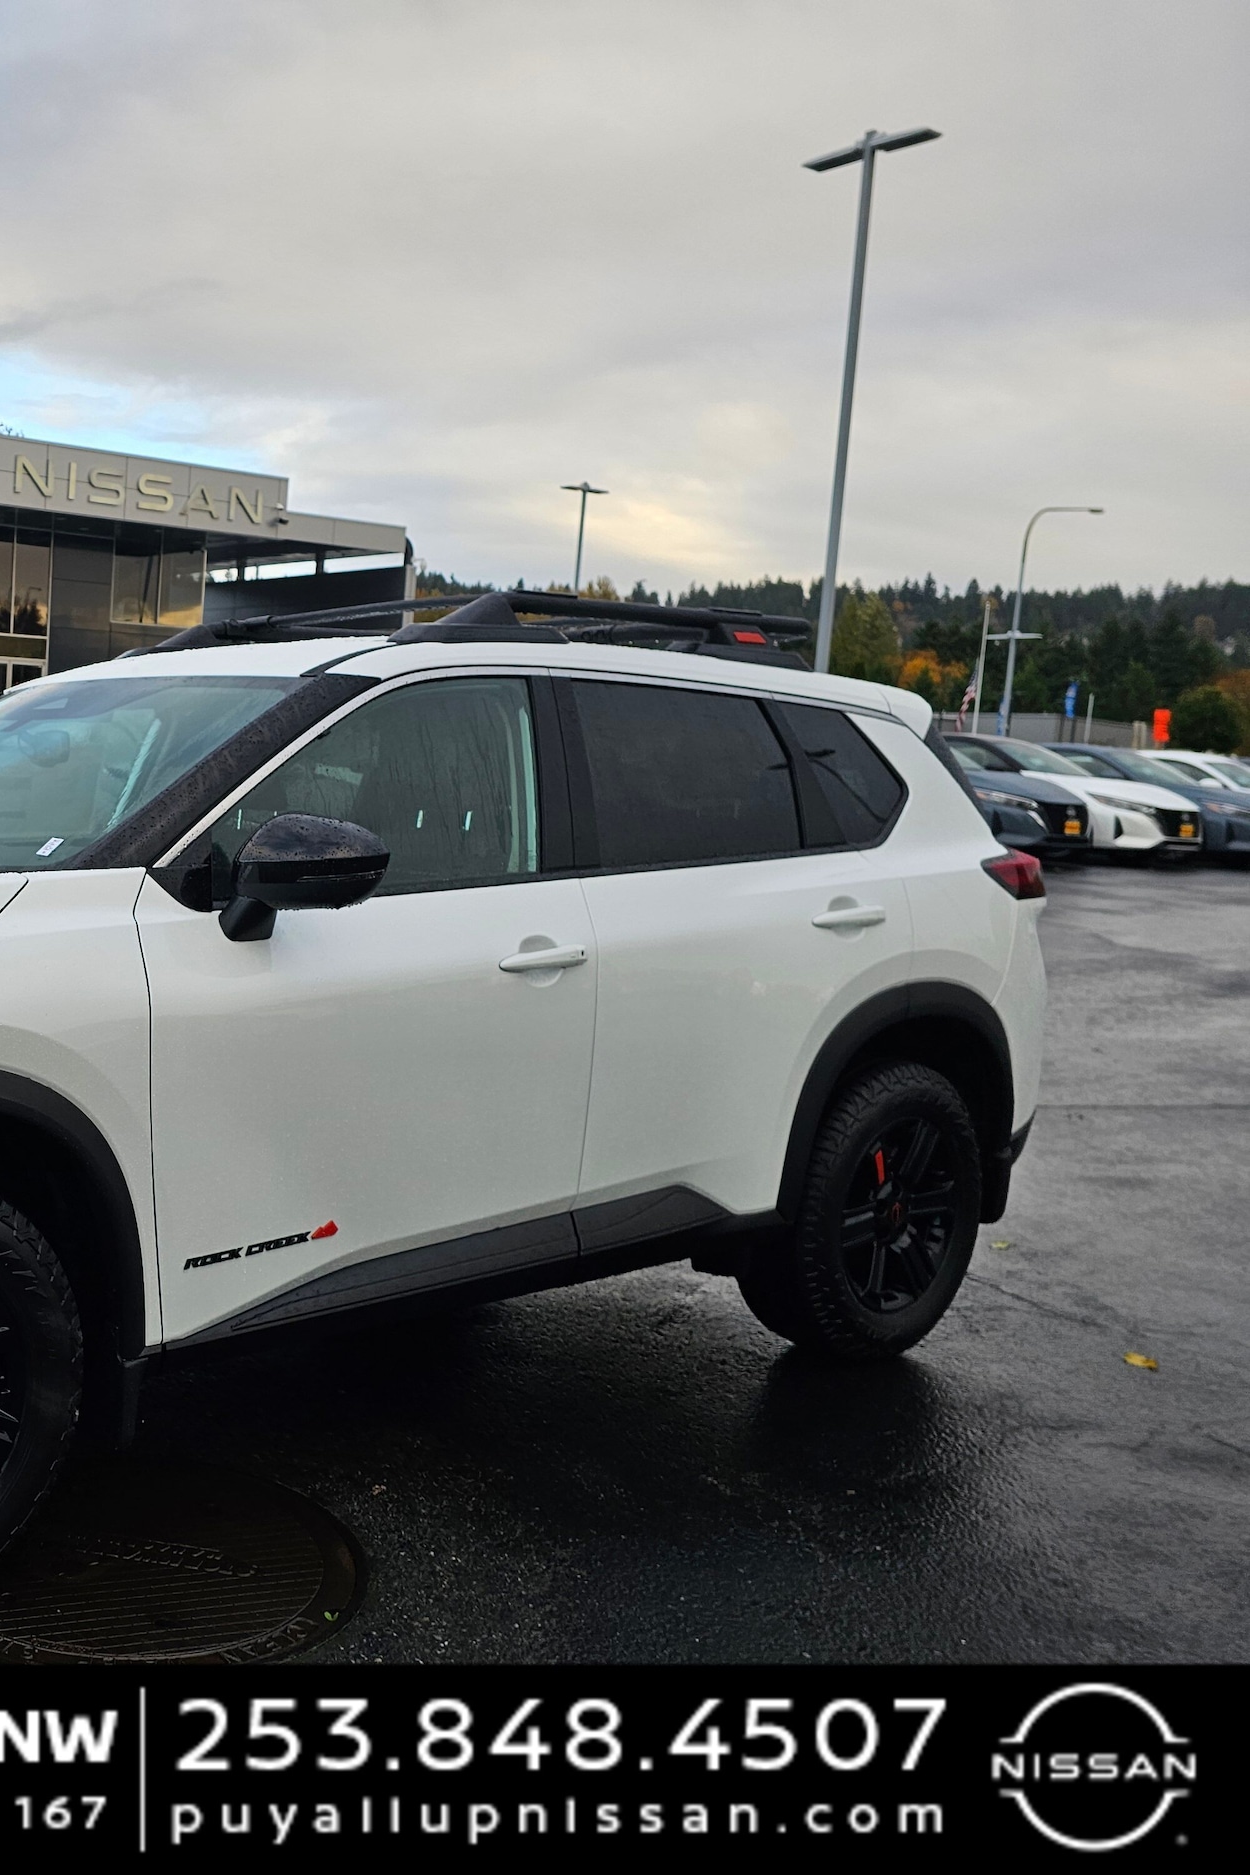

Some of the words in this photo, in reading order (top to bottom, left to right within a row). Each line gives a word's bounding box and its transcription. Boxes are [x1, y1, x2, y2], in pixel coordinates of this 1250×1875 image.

[13, 454, 264, 525] NISSAN
[183, 1246, 244, 1271] ROCK
[245, 1230, 311, 1257] CREEK
